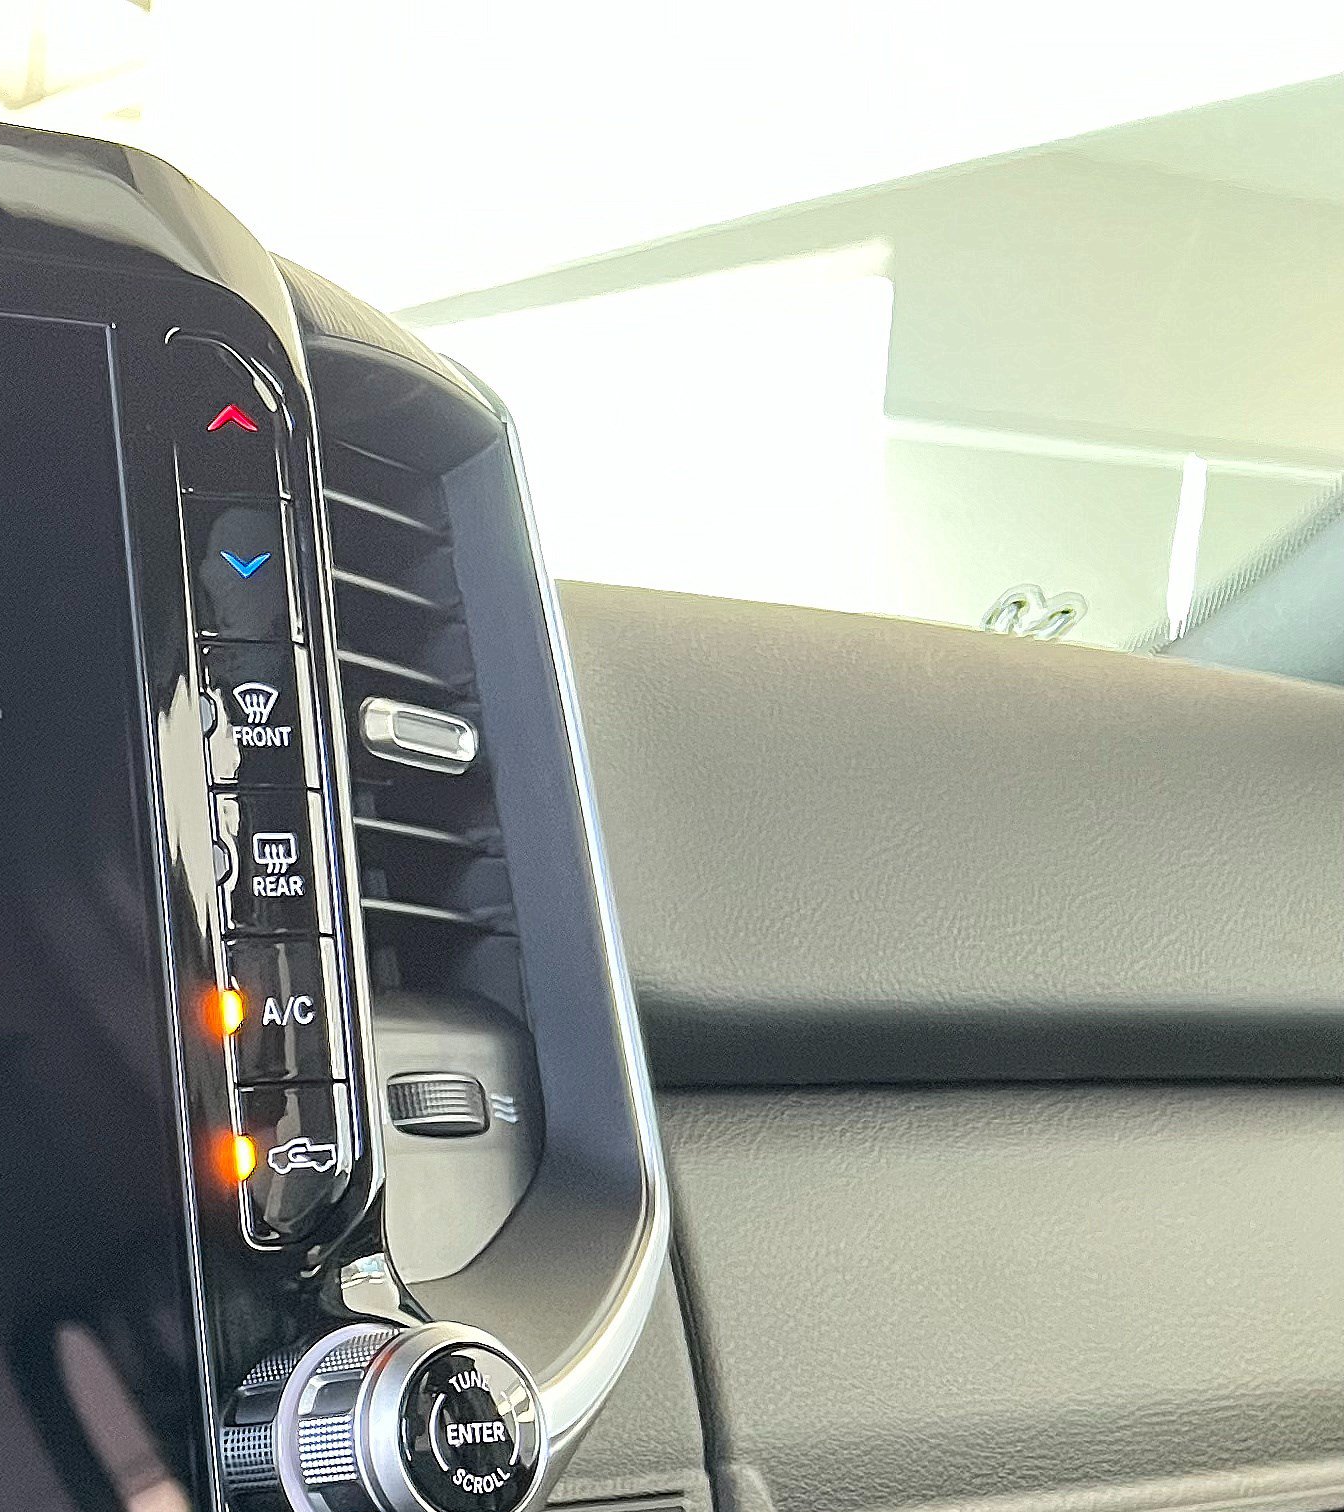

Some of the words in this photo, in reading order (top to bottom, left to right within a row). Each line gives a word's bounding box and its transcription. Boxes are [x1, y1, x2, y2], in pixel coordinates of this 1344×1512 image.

[232, 726, 292, 747] FRONT
[252, 875, 305, 897] REAR
[261, 996, 316, 1026] A/C
[446, 1421, 506, 1447] ENTER
[452, 1466, 511, 1494] SCROLL
